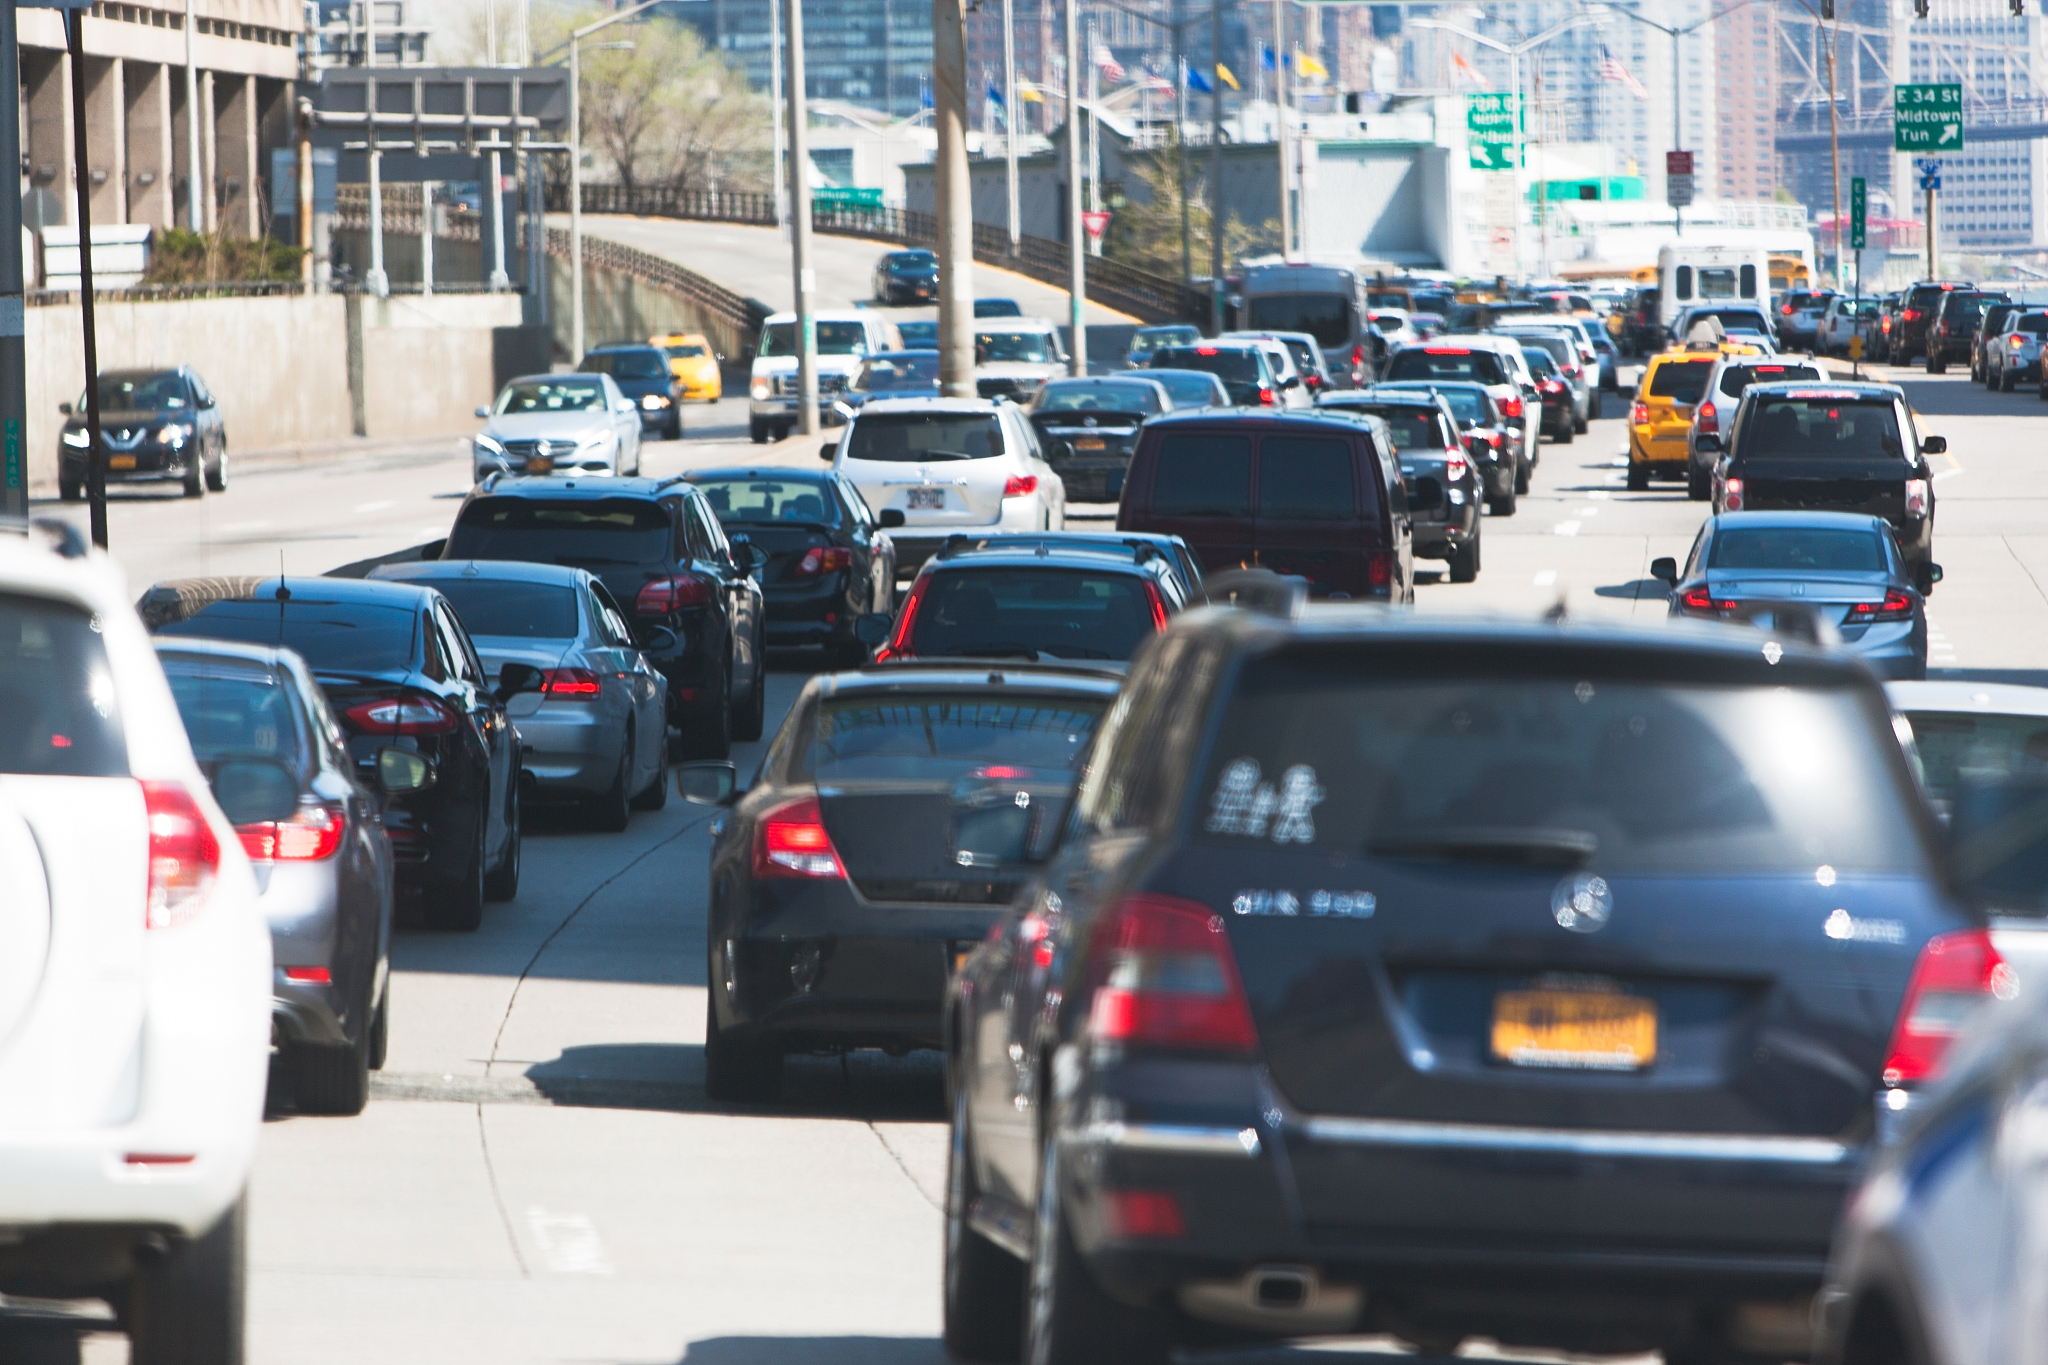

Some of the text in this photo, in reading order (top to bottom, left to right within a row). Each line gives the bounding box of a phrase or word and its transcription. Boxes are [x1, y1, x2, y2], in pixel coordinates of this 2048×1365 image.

[1896, 88, 1959, 103] E 34 St
[1896, 109, 1961, 122] Midtown
[1900, 127, 1929, 142] Tun
[1854, 182, 1862, 232] EXIT
